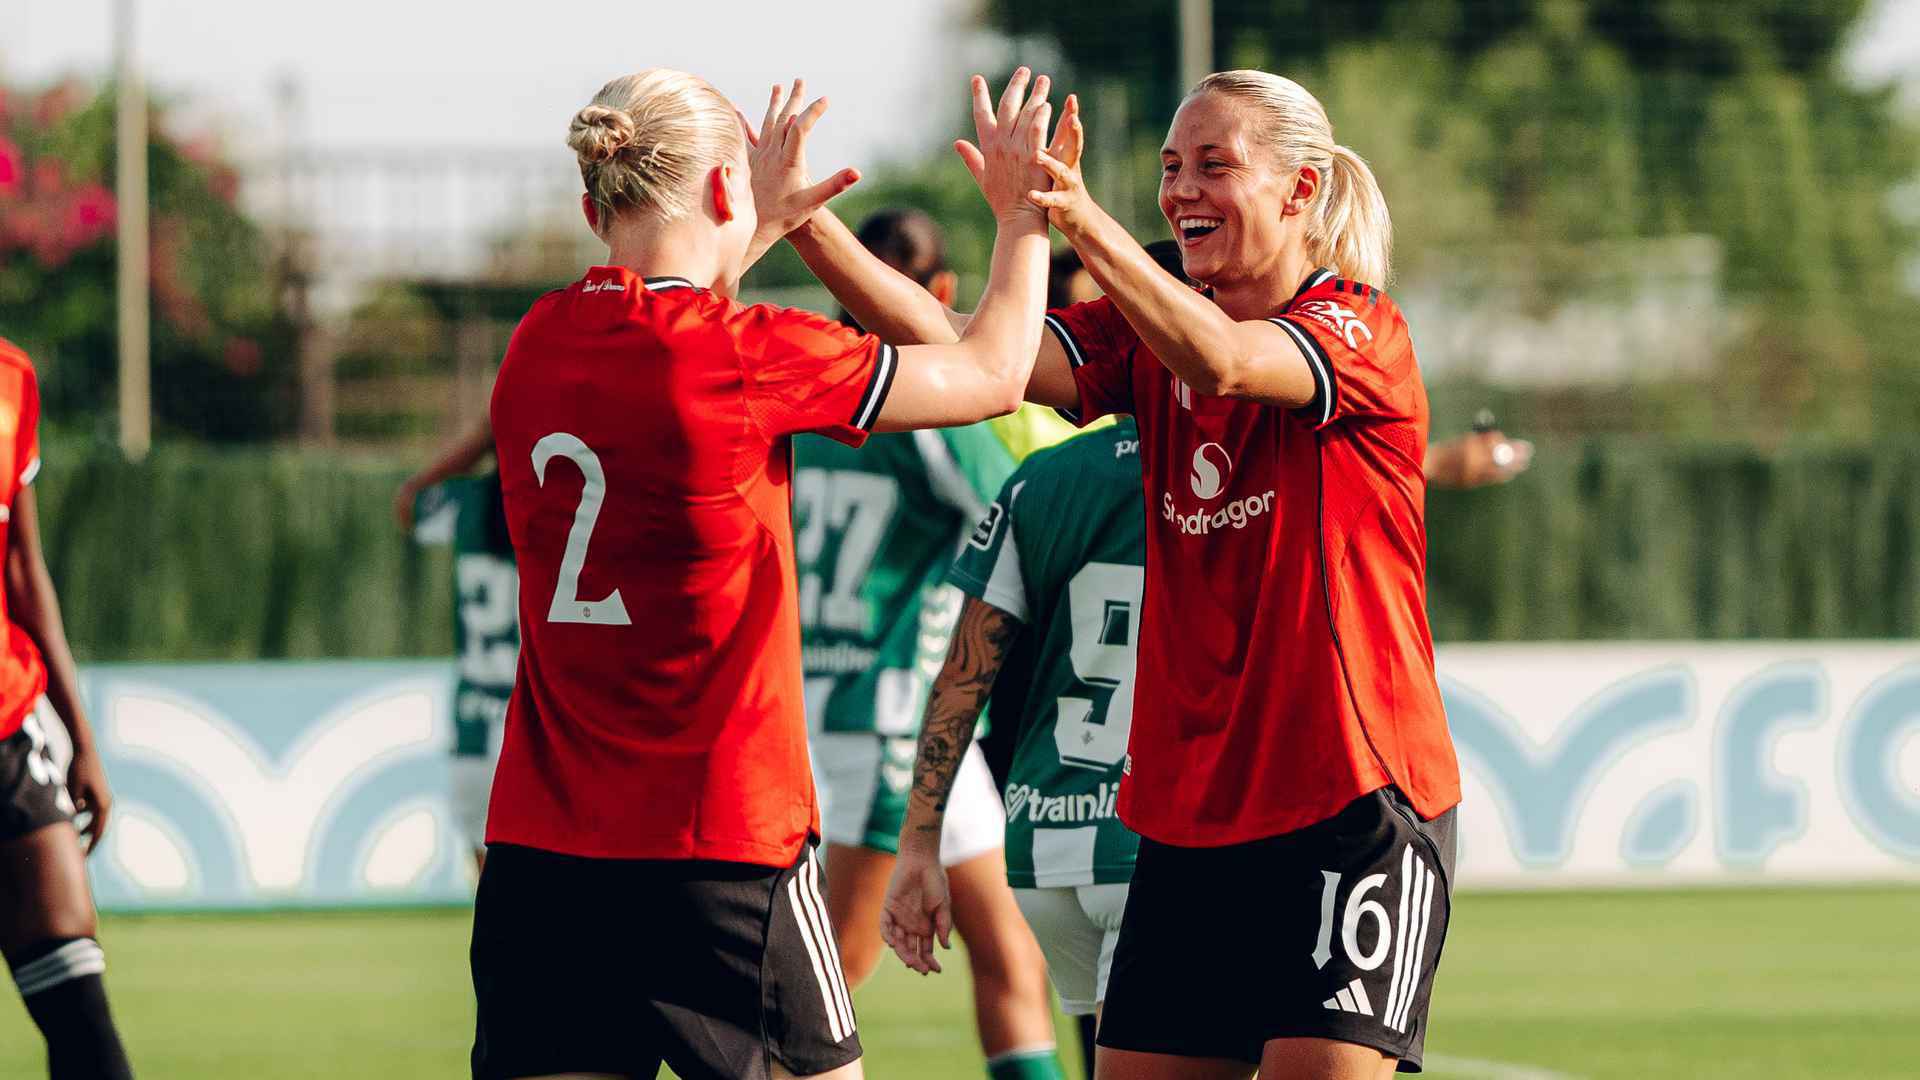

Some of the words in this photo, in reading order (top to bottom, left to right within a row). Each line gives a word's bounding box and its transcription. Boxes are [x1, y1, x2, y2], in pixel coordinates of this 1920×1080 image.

[531, 432, 632, 625] 2
[1054, 561, 1144, 772] 9
[1027, 782, 1120, 823] trainli
[1311, 869, 1392, 971] 16
